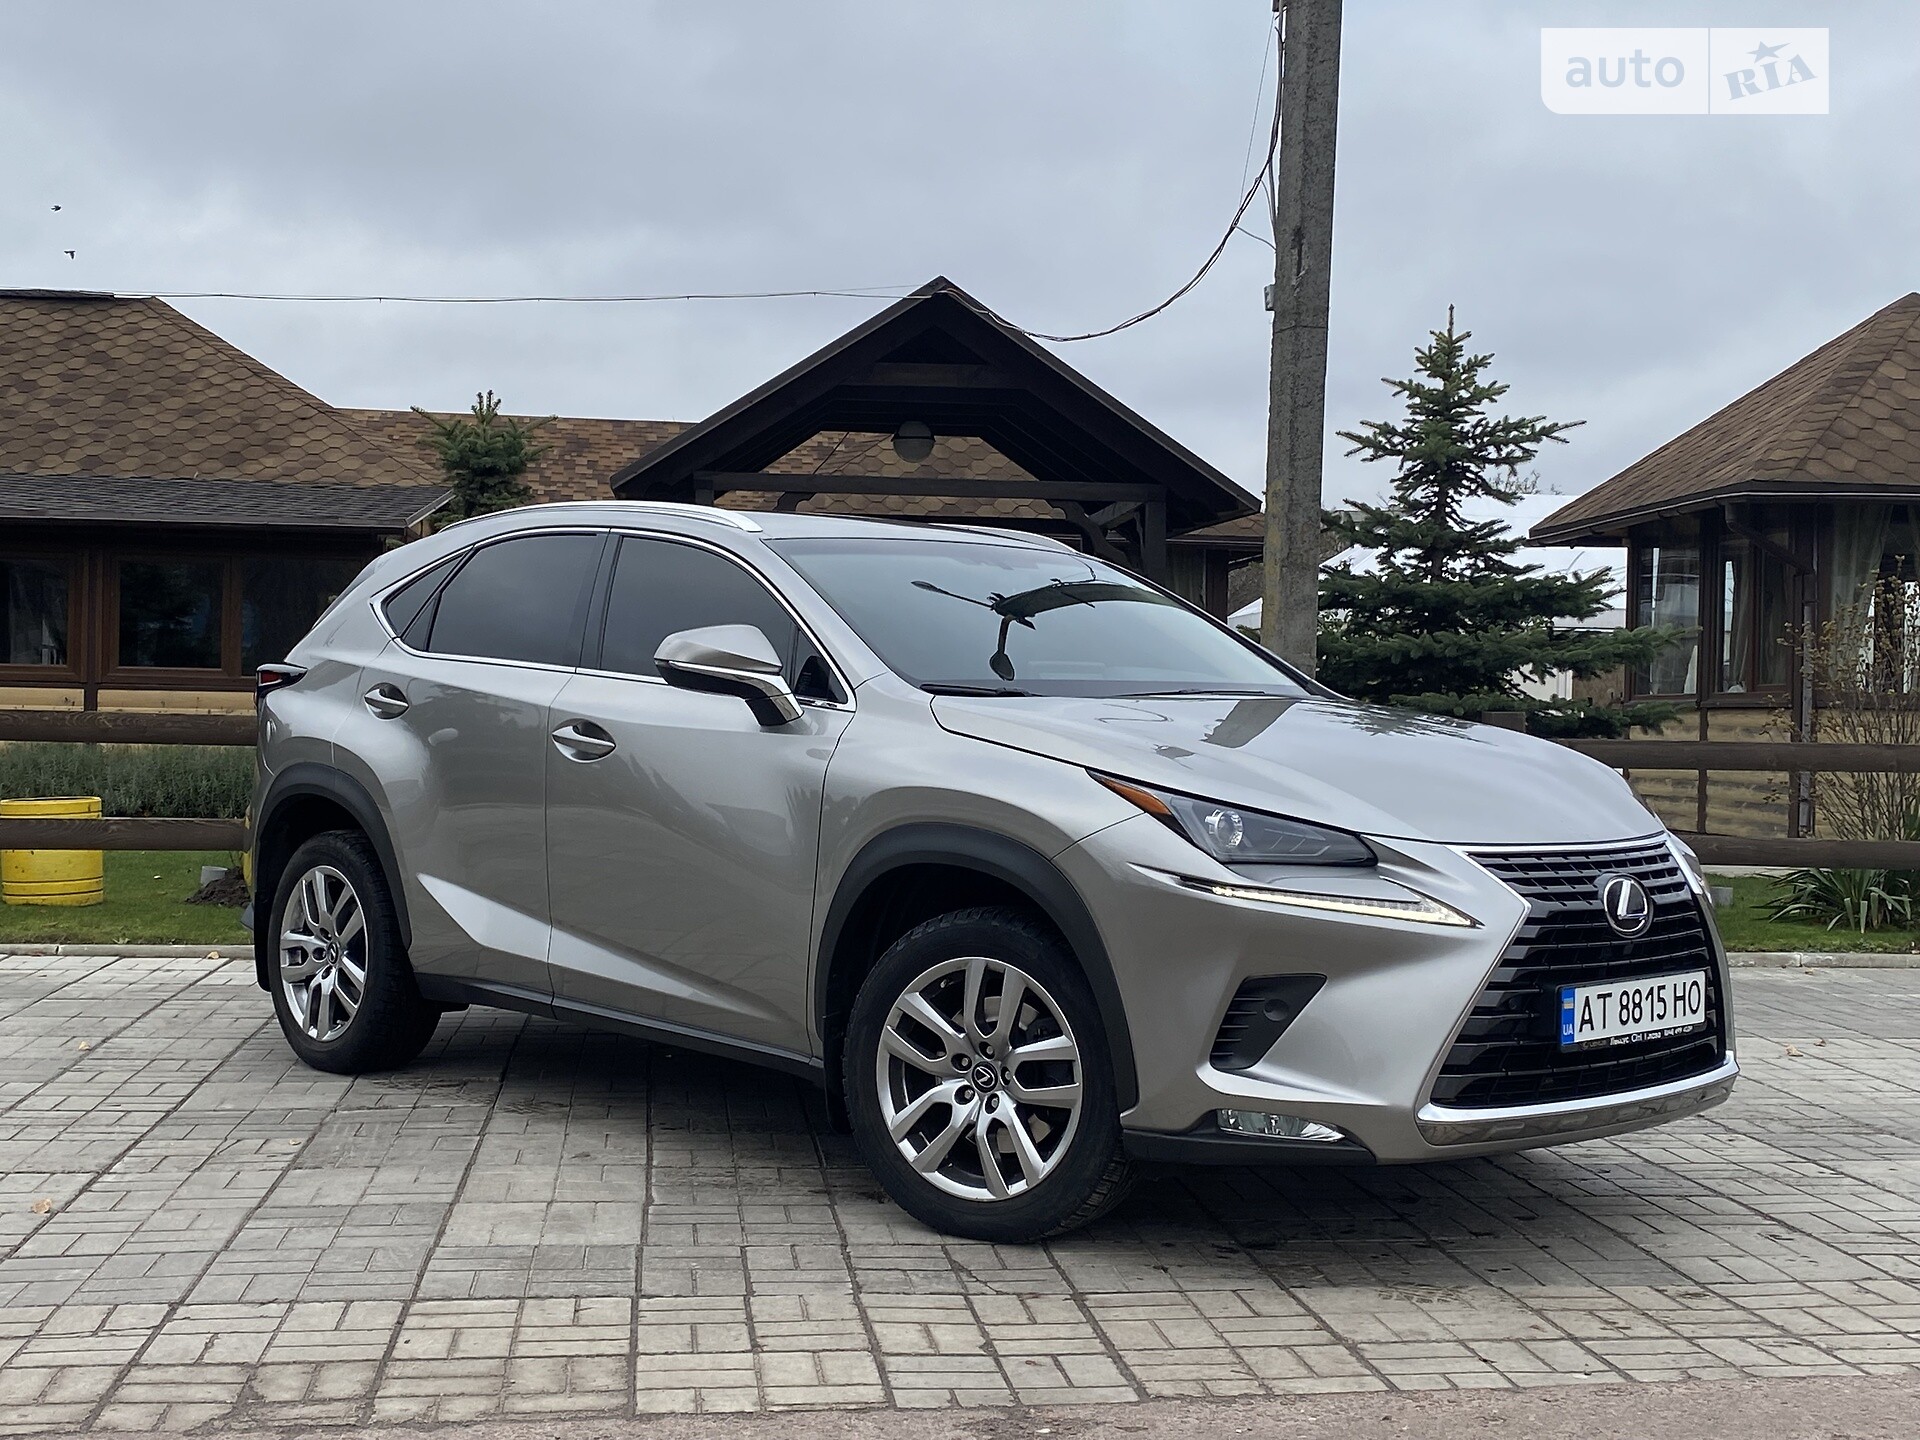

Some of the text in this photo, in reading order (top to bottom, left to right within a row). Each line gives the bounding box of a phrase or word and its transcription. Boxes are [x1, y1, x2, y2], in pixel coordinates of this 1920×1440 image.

[1579, 979, 1702, 1032] AT 8815 HO
[1563, 1025, 1574, 1036] UA
